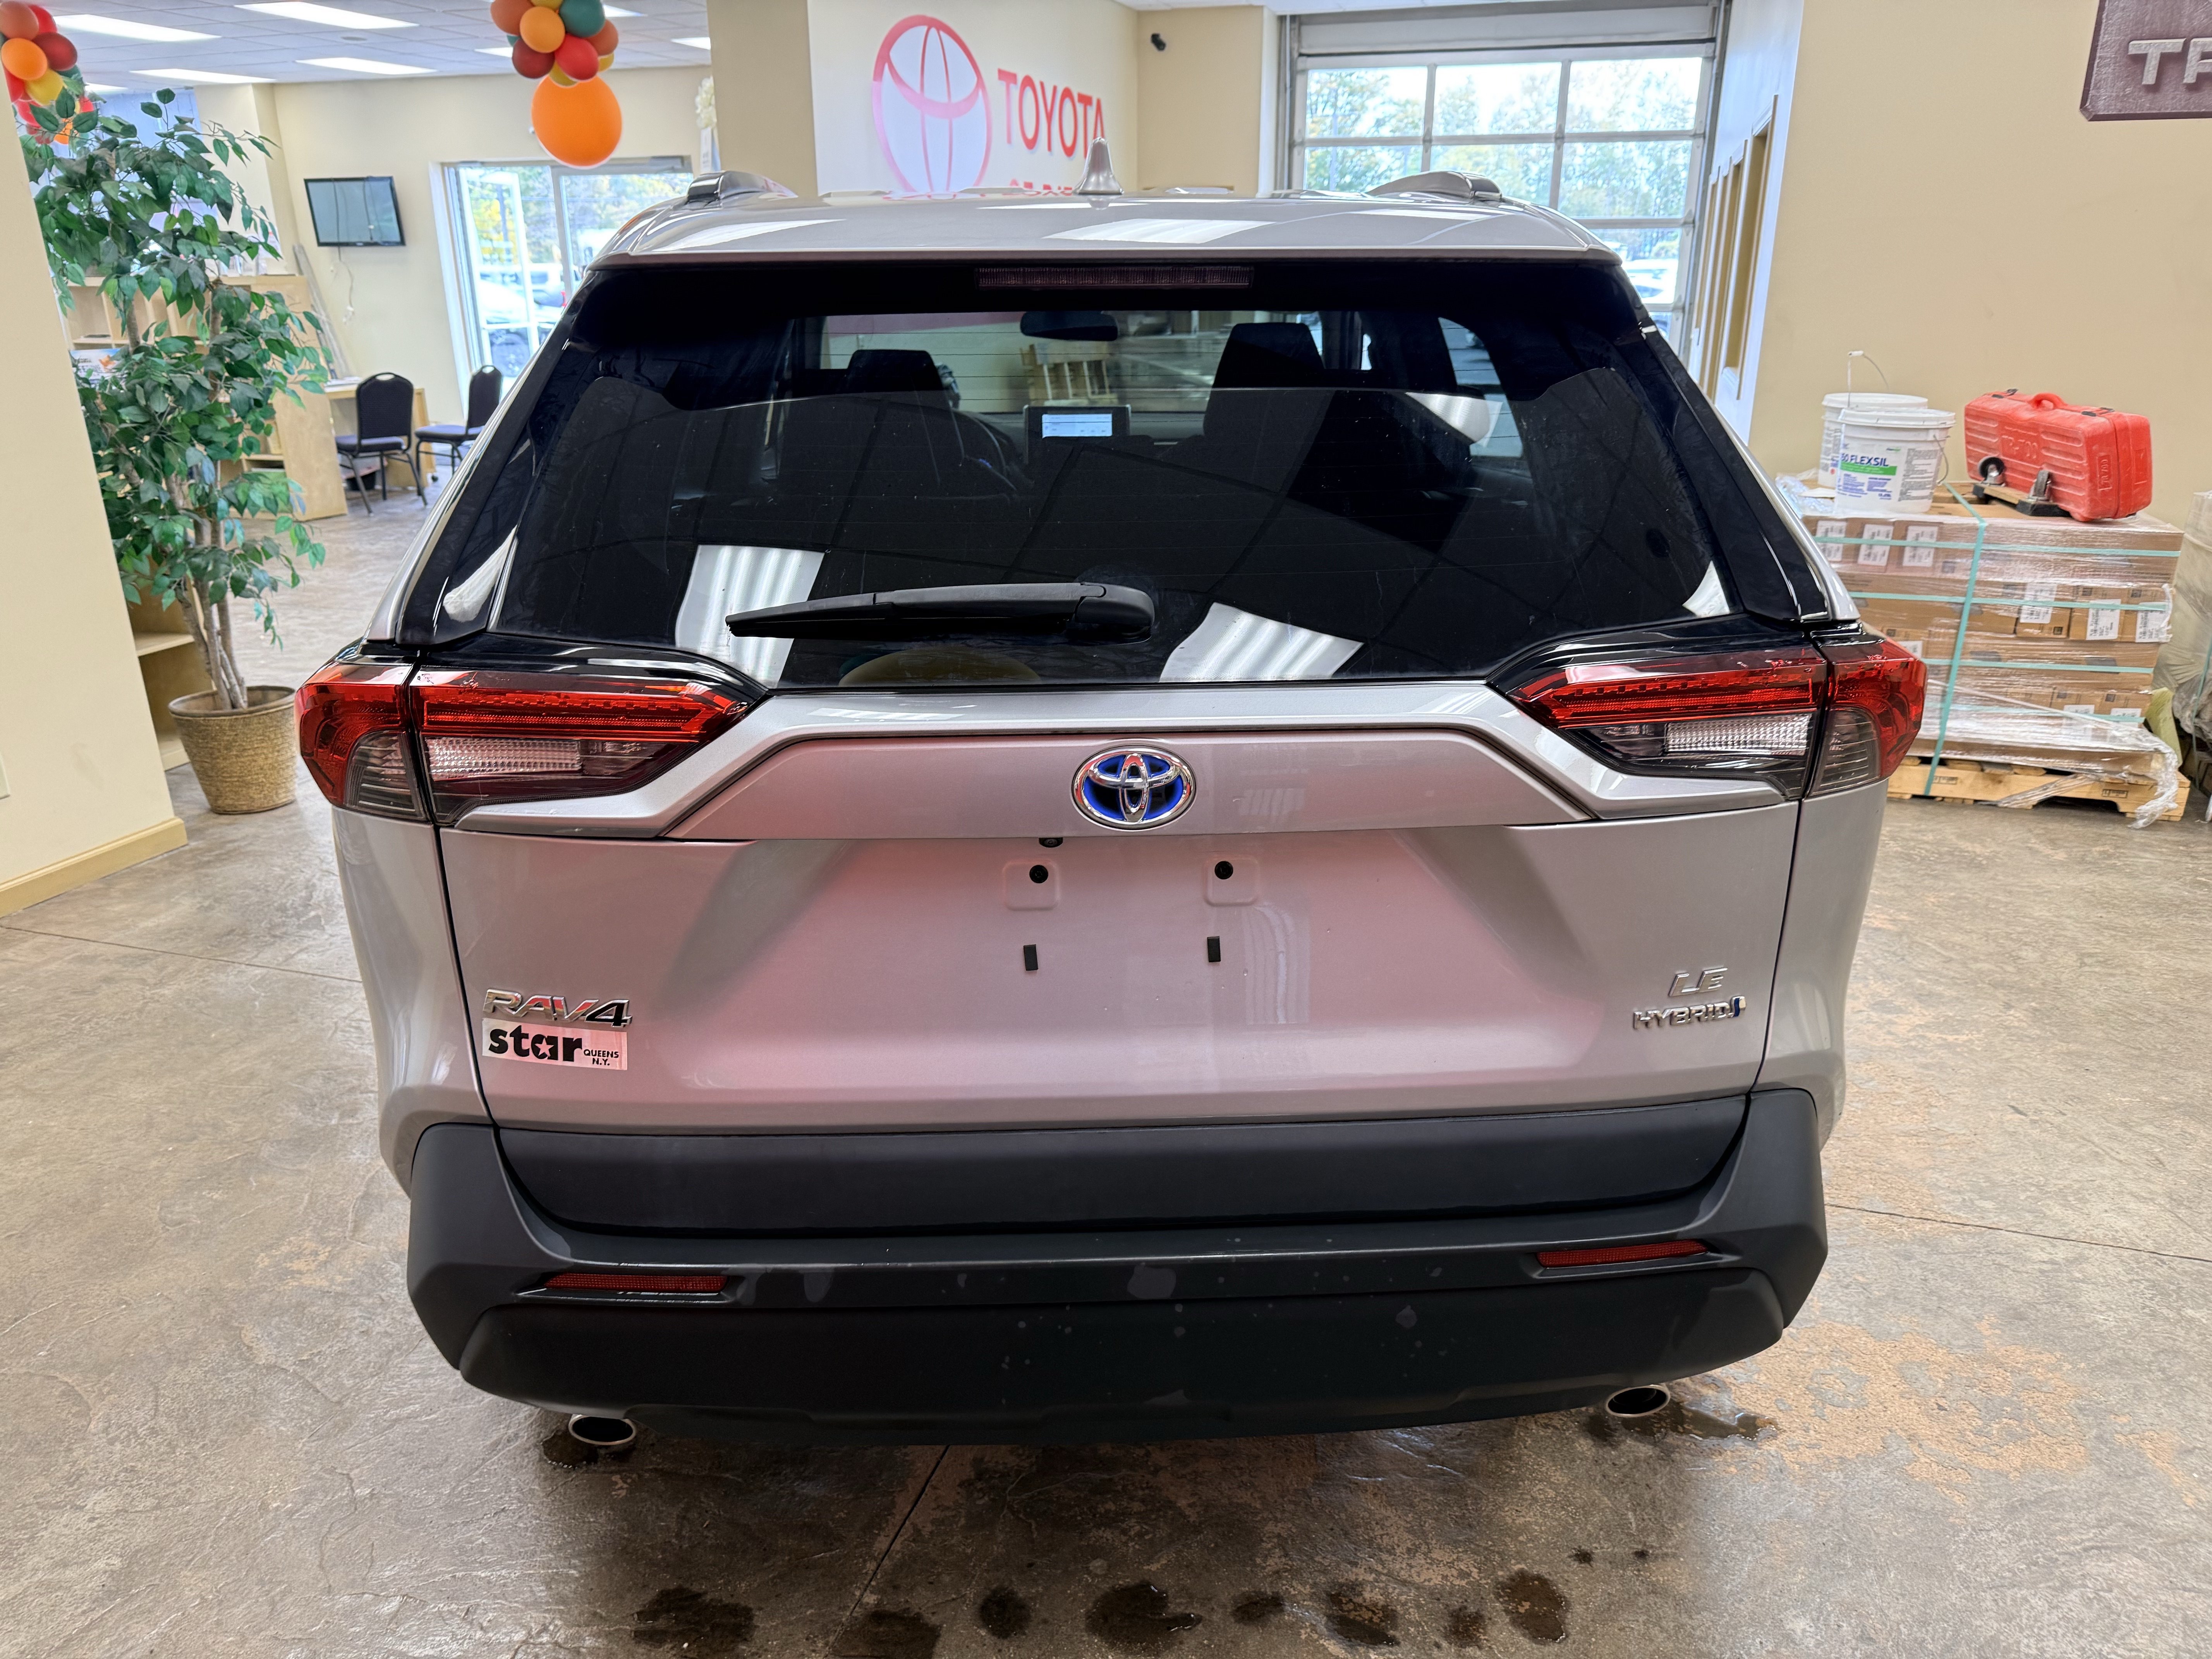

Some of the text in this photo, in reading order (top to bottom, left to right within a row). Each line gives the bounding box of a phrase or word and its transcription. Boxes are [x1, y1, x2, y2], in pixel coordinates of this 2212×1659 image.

[1850, 454, 1889, 467] FLEXSIL
[1668, 967, 1728, 996] LE
[483, 988, 633, 1028] RAV4
[1633, 1001, 1731, 1030] HYBRID
[488, 1025, 583, 1062] star
[583, 1049, 619, 1058] QUEENS
[592, 1058, 610, 1066] N.Y.
